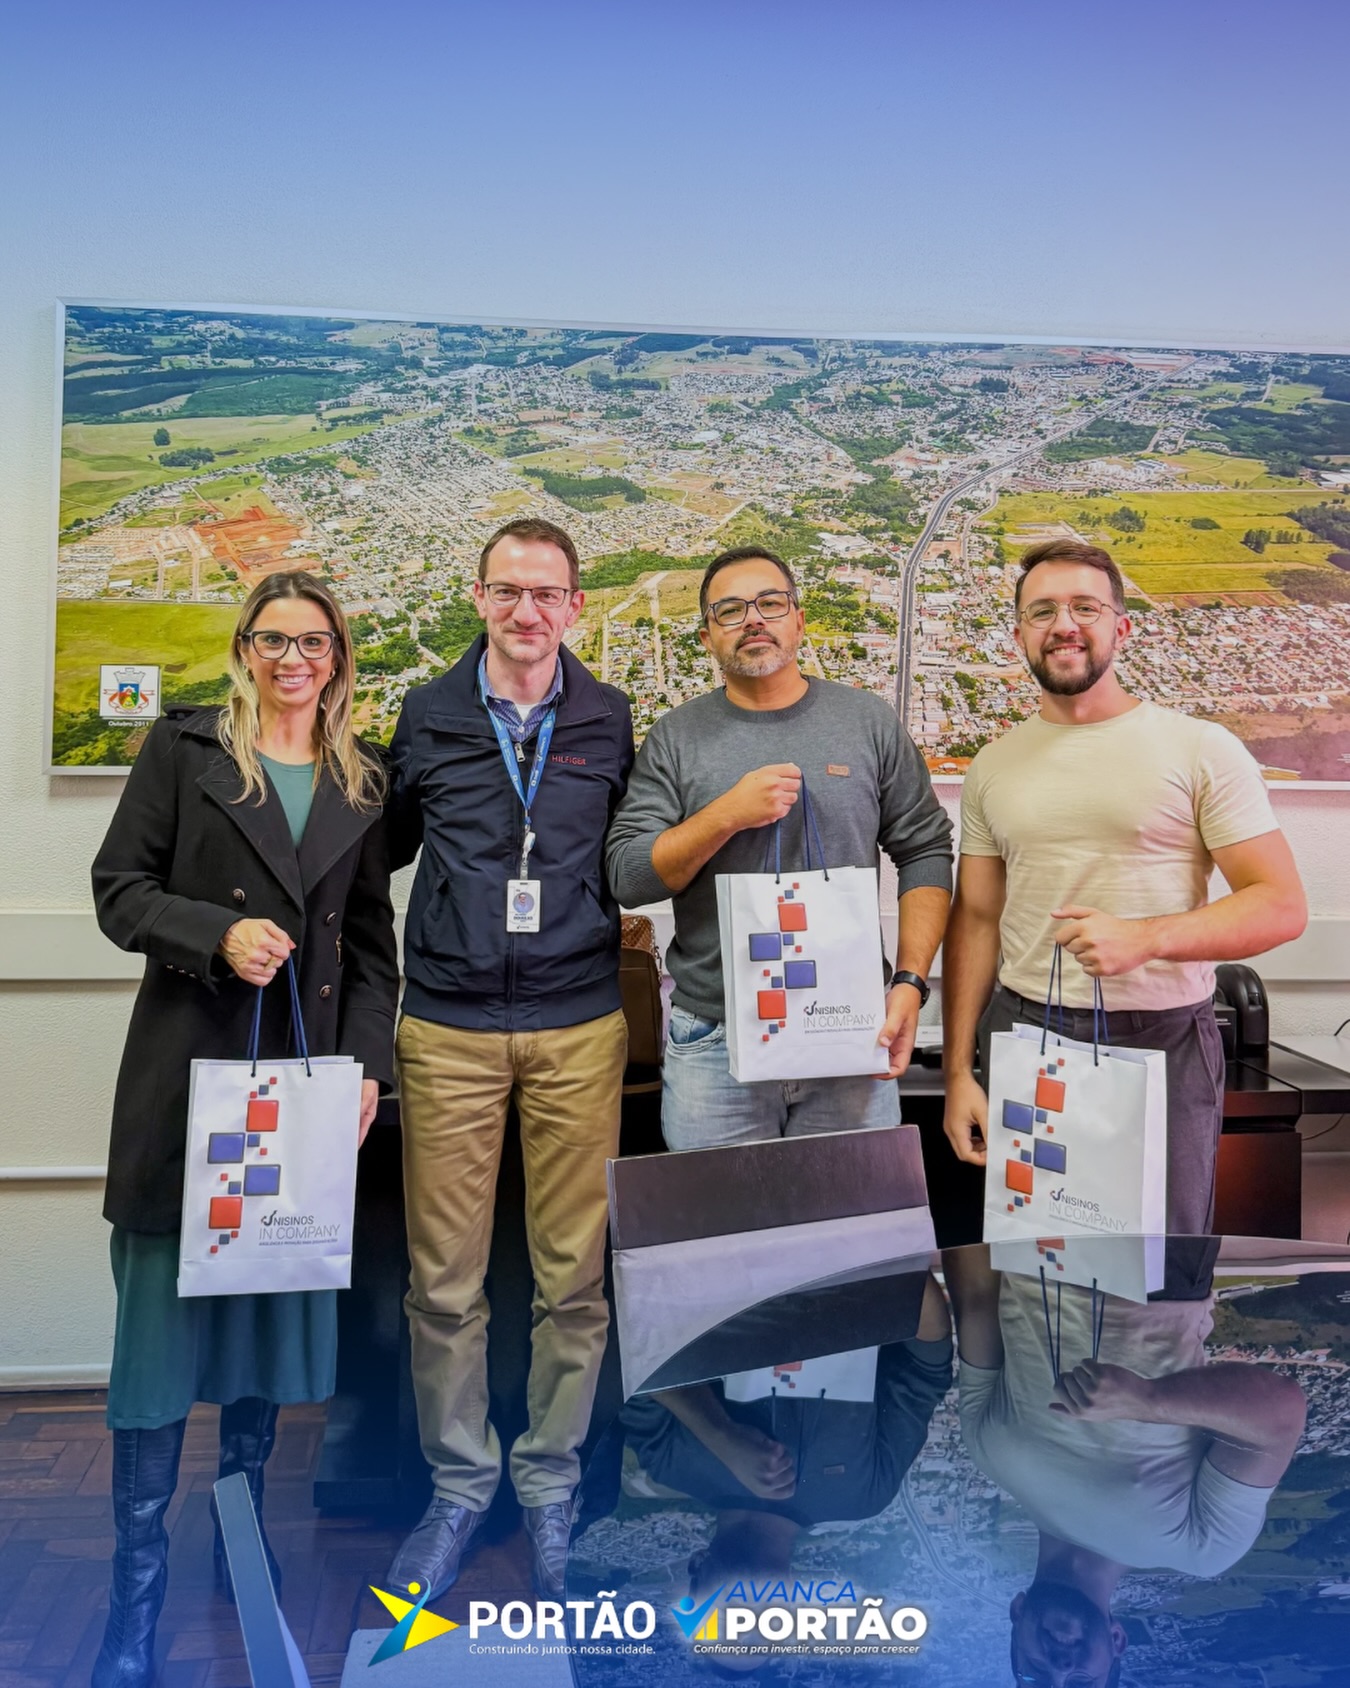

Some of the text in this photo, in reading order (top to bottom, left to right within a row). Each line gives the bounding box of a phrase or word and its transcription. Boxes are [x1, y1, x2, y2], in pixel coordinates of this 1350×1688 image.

[551, 755, 587, 766] HILFIGER
[803, 1013, 876, 1028] IN COMPANY
[1049, 1200, 1061, 1215] IN
[1064, 1204, 1128, 1232] COMPANY
[258, 1224, 341, 1240] IN COMPANY
